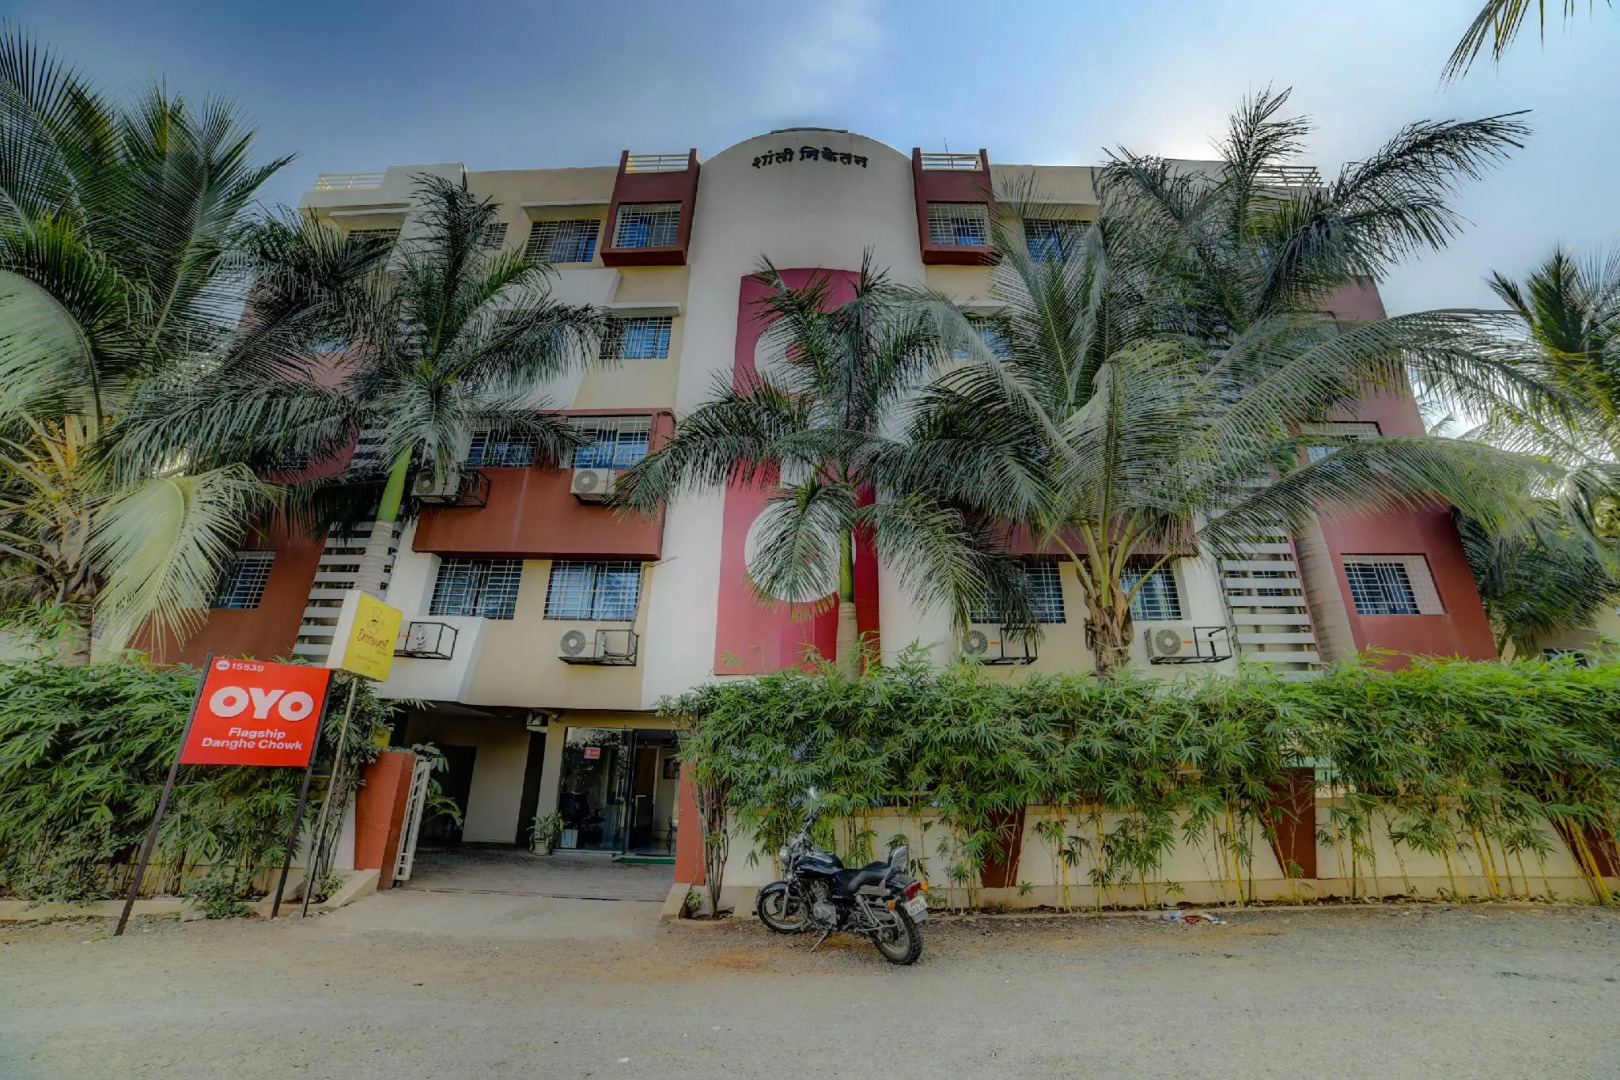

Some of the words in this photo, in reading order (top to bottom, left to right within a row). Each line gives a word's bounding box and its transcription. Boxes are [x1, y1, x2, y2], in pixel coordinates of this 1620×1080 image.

[799, 146, 868, 168] निकेतन
[209, 686, 314, 721] OYO
[228, 727, 286, 740] Flagship
[201, 737, 256, 750] Danghe
[258, 739, 303, 750] Chowk
